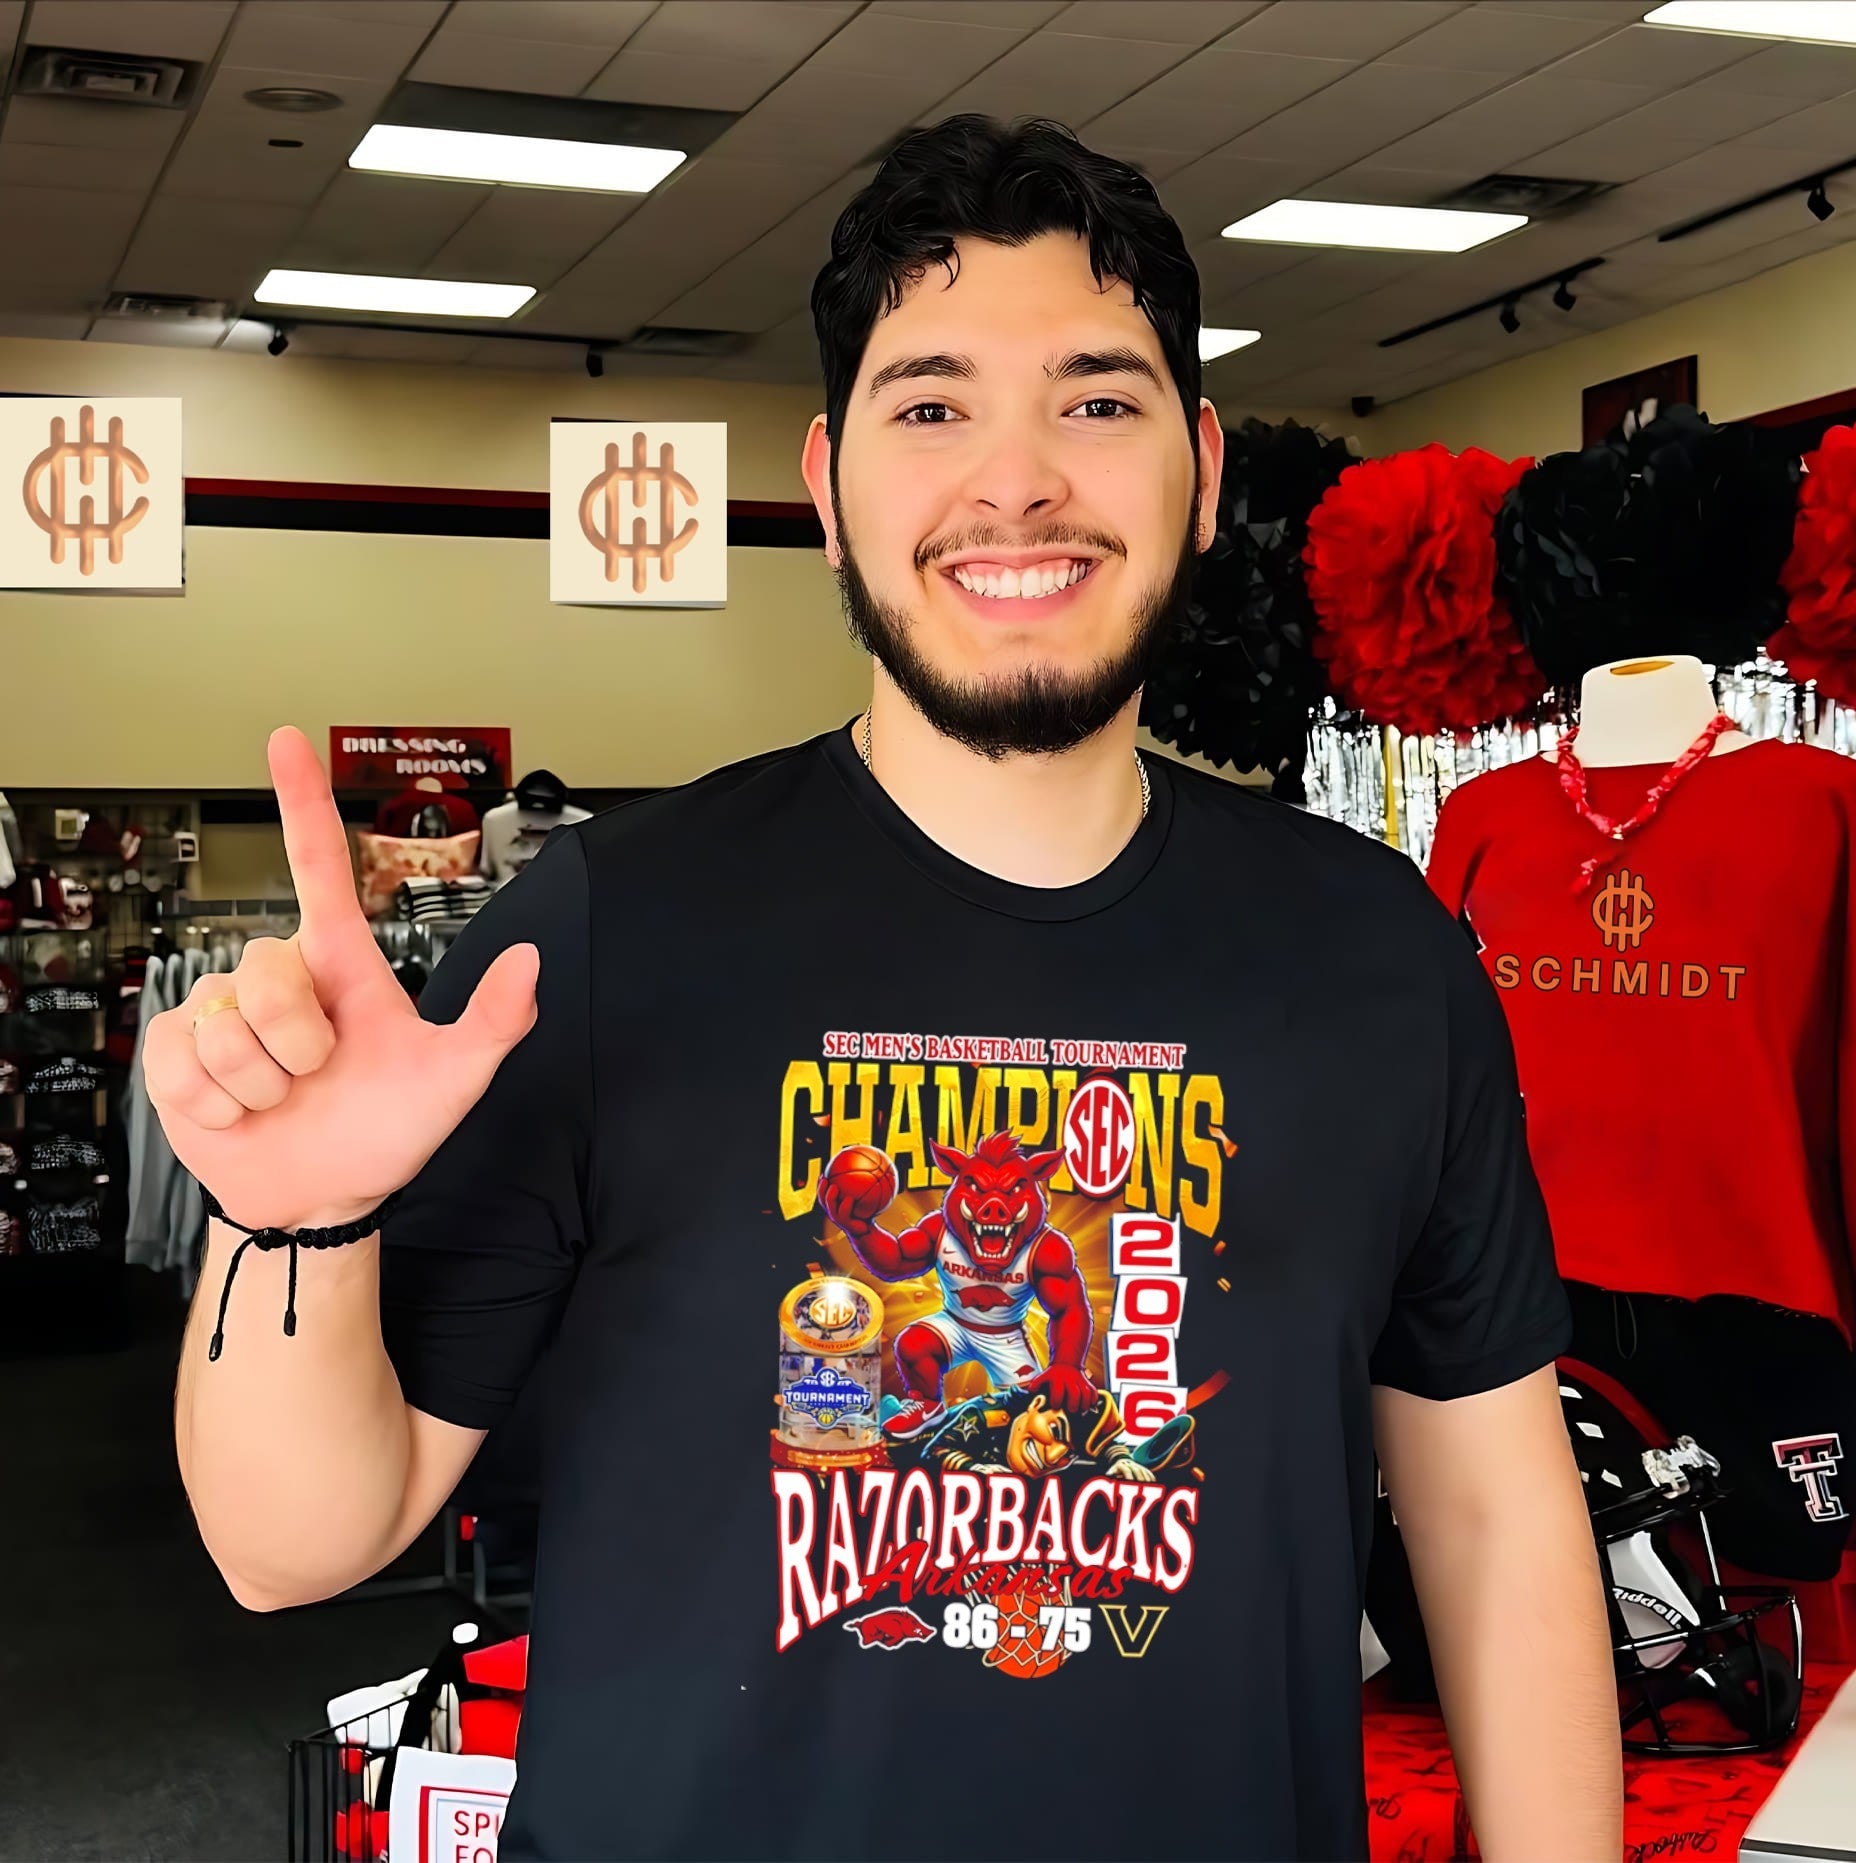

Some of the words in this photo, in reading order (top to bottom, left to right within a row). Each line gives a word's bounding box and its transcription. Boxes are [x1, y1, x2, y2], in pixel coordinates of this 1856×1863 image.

[342, 737, 467, 753] DRESSING
[396, 758, 487, 774] ROOMS
[1494, 954, 1746, 999] SCHMIDT
[823, 1031, 859, 1057] SEC
[864, 1033, 923, 1060] MEN'S
[925, 1035, 1049, 1064] BASKETBALL
[1053, 1039, 1186, 1069] TOURNAMENT
[1069, 1079, 1130, 1194] SEC
[943, 1261, 1024, 1284] ARKANSAS
[811, 1298, 855, 1327] SEC
[785, 1391, 870, 1406] TOURNAMENT
[770, 1465, 1199, 1653] RAZORBACKS
[858, 1540, 1135, 1603] Arkansas
[942, 1601, 1000, 1650] 86
[1038, 1606, 1093, 1653] 75
